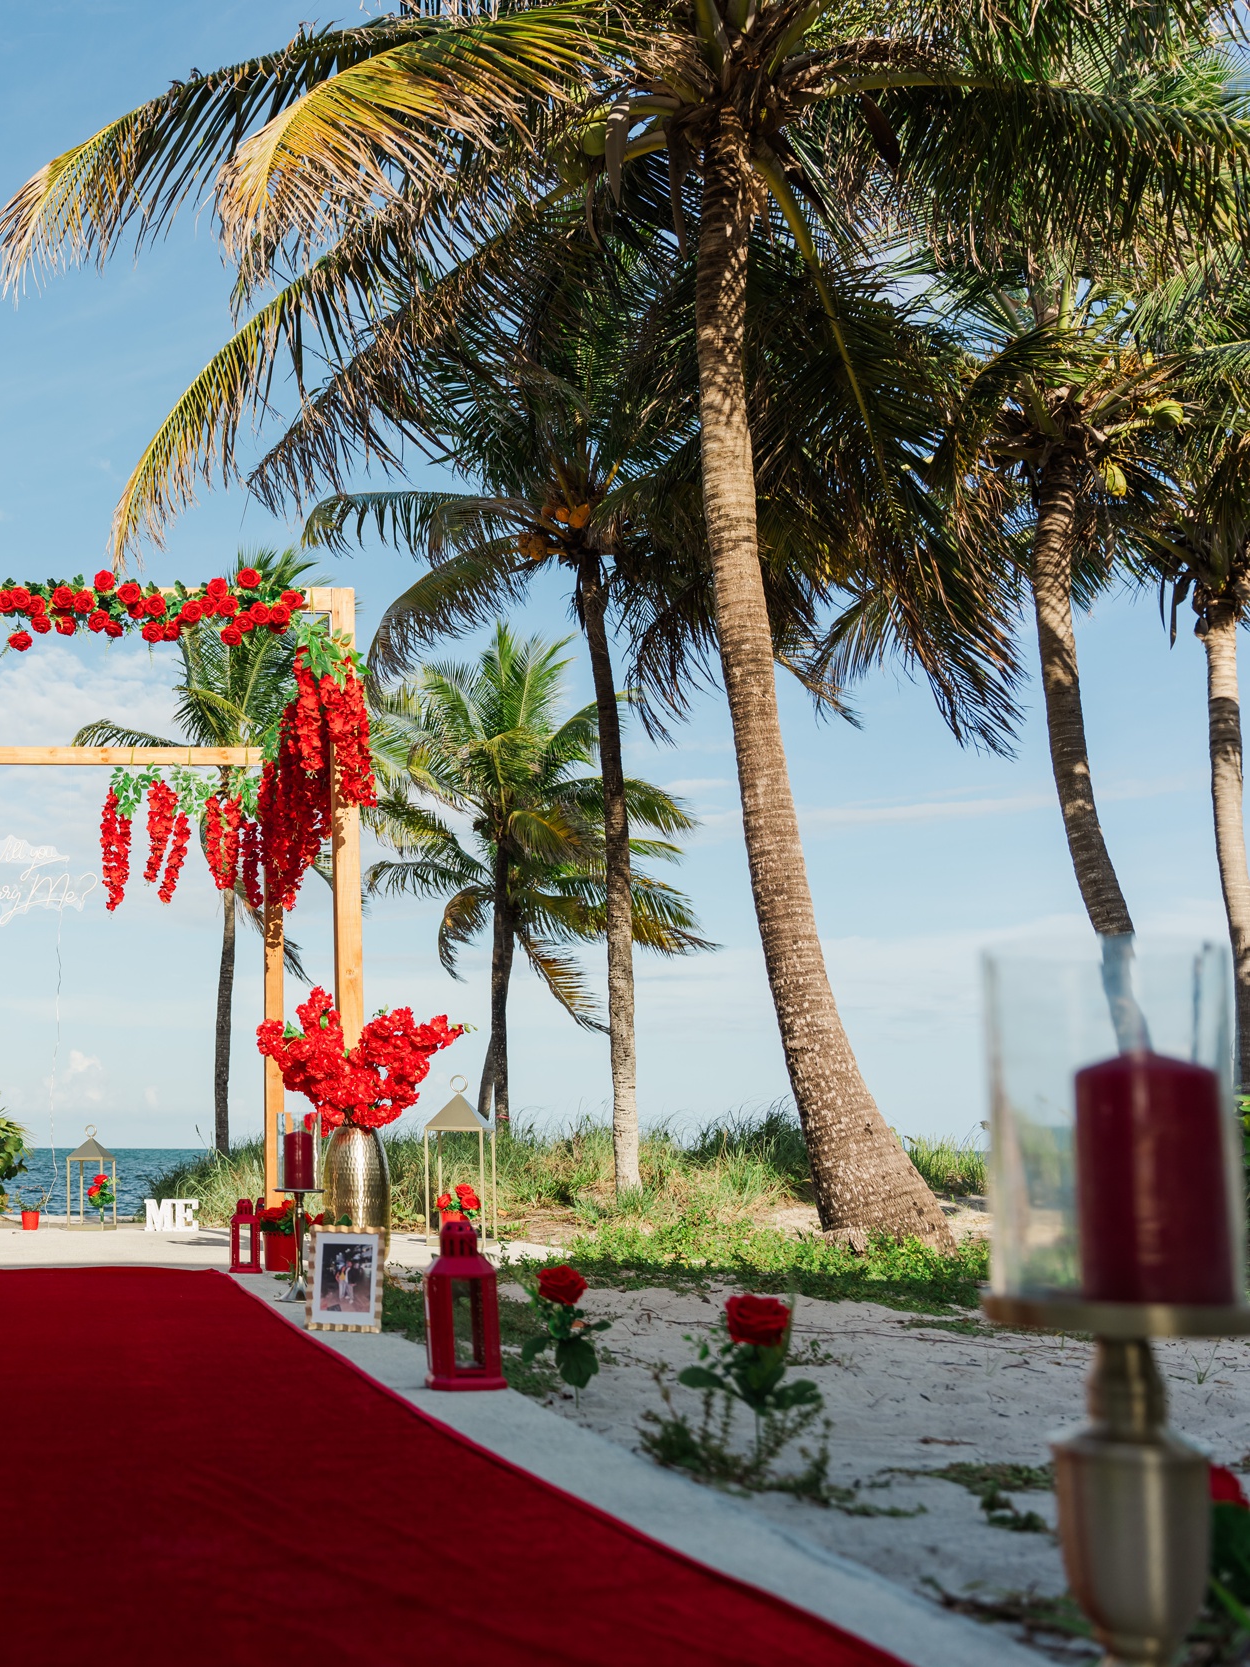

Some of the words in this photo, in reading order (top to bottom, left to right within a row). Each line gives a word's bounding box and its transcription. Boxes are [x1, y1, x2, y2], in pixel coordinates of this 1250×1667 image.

[20, 846, 70, 881] you
[23, 873, 98, 911] Me?
[144, 1198, 199, 1231] ME
